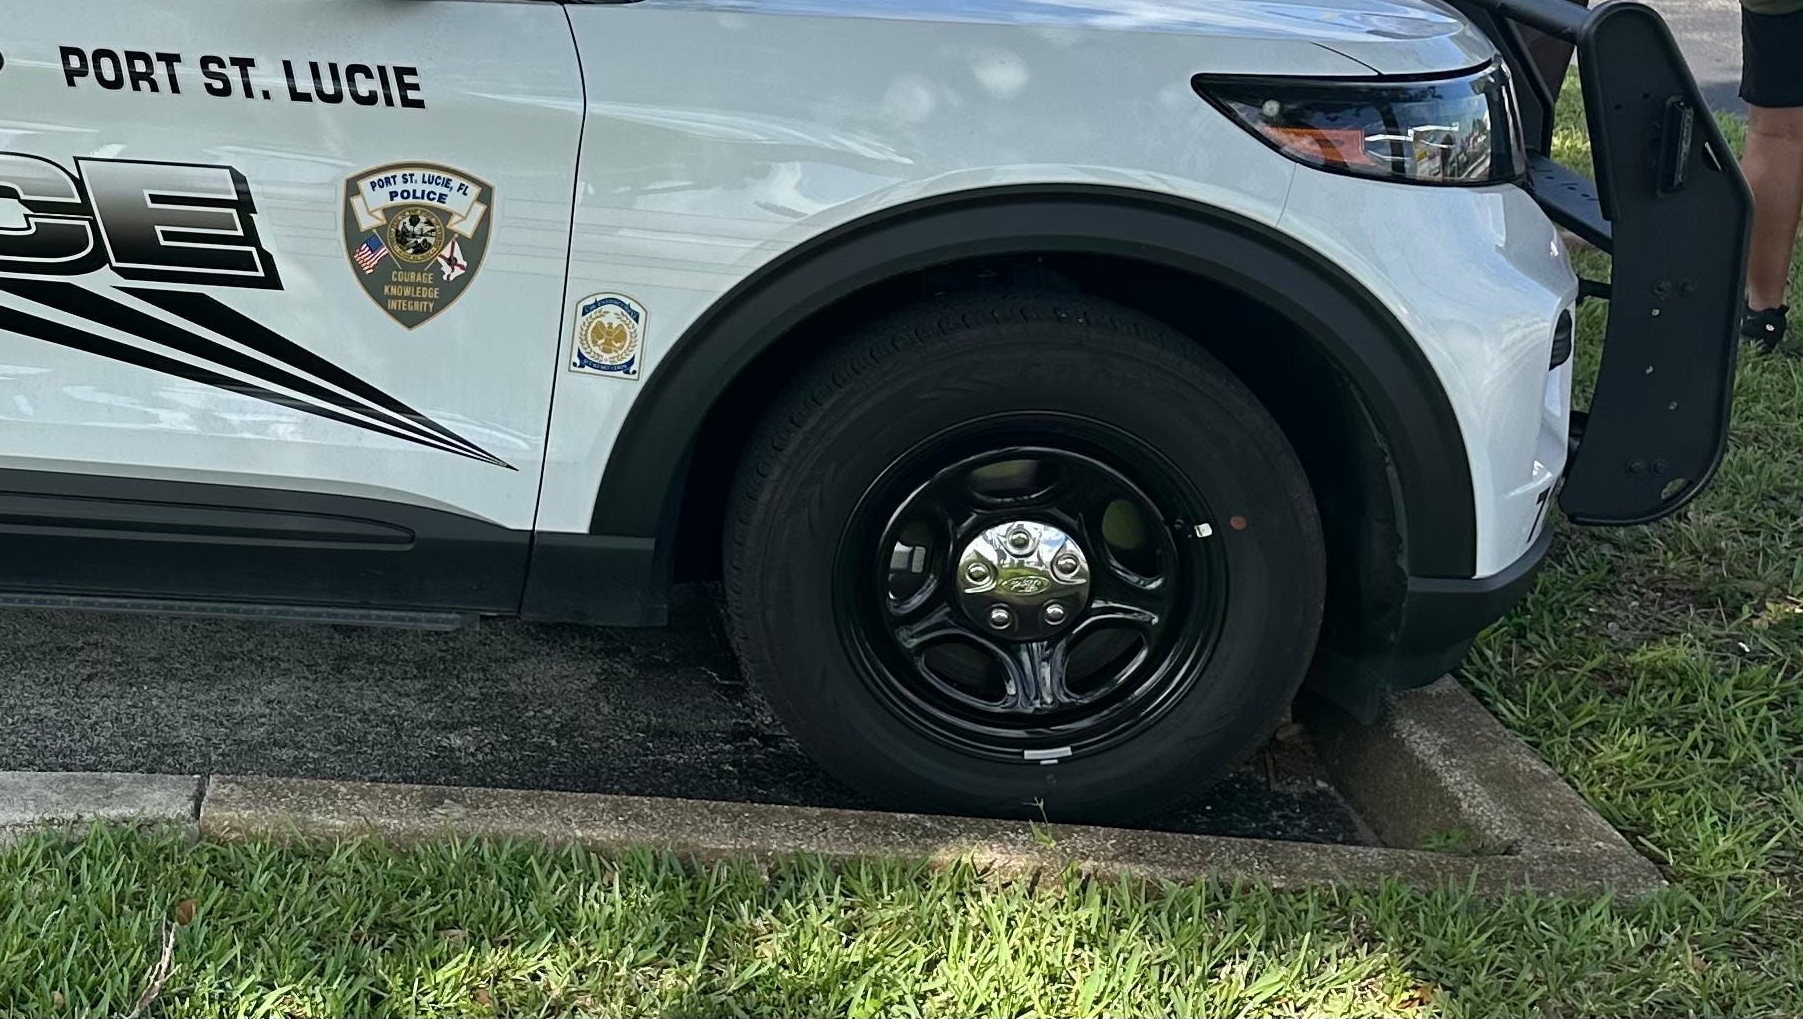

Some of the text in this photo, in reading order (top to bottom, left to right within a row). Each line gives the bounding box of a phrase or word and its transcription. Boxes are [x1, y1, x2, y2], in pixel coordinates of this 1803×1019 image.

[58, 45, 426, 110] PORT ST. LUCIE
[370, 174, 398, 192] PORT
[421, 173, 453, 192] LUCIE,
[456, 181, 470, 197] FL
[389, 189, 448, 204] POLICE
[391, 270, 434, 284] COURAGE
[384, 285, 439, 299] KNOWLEDGE
[387, 298, 435, 312] INTEGRITY
